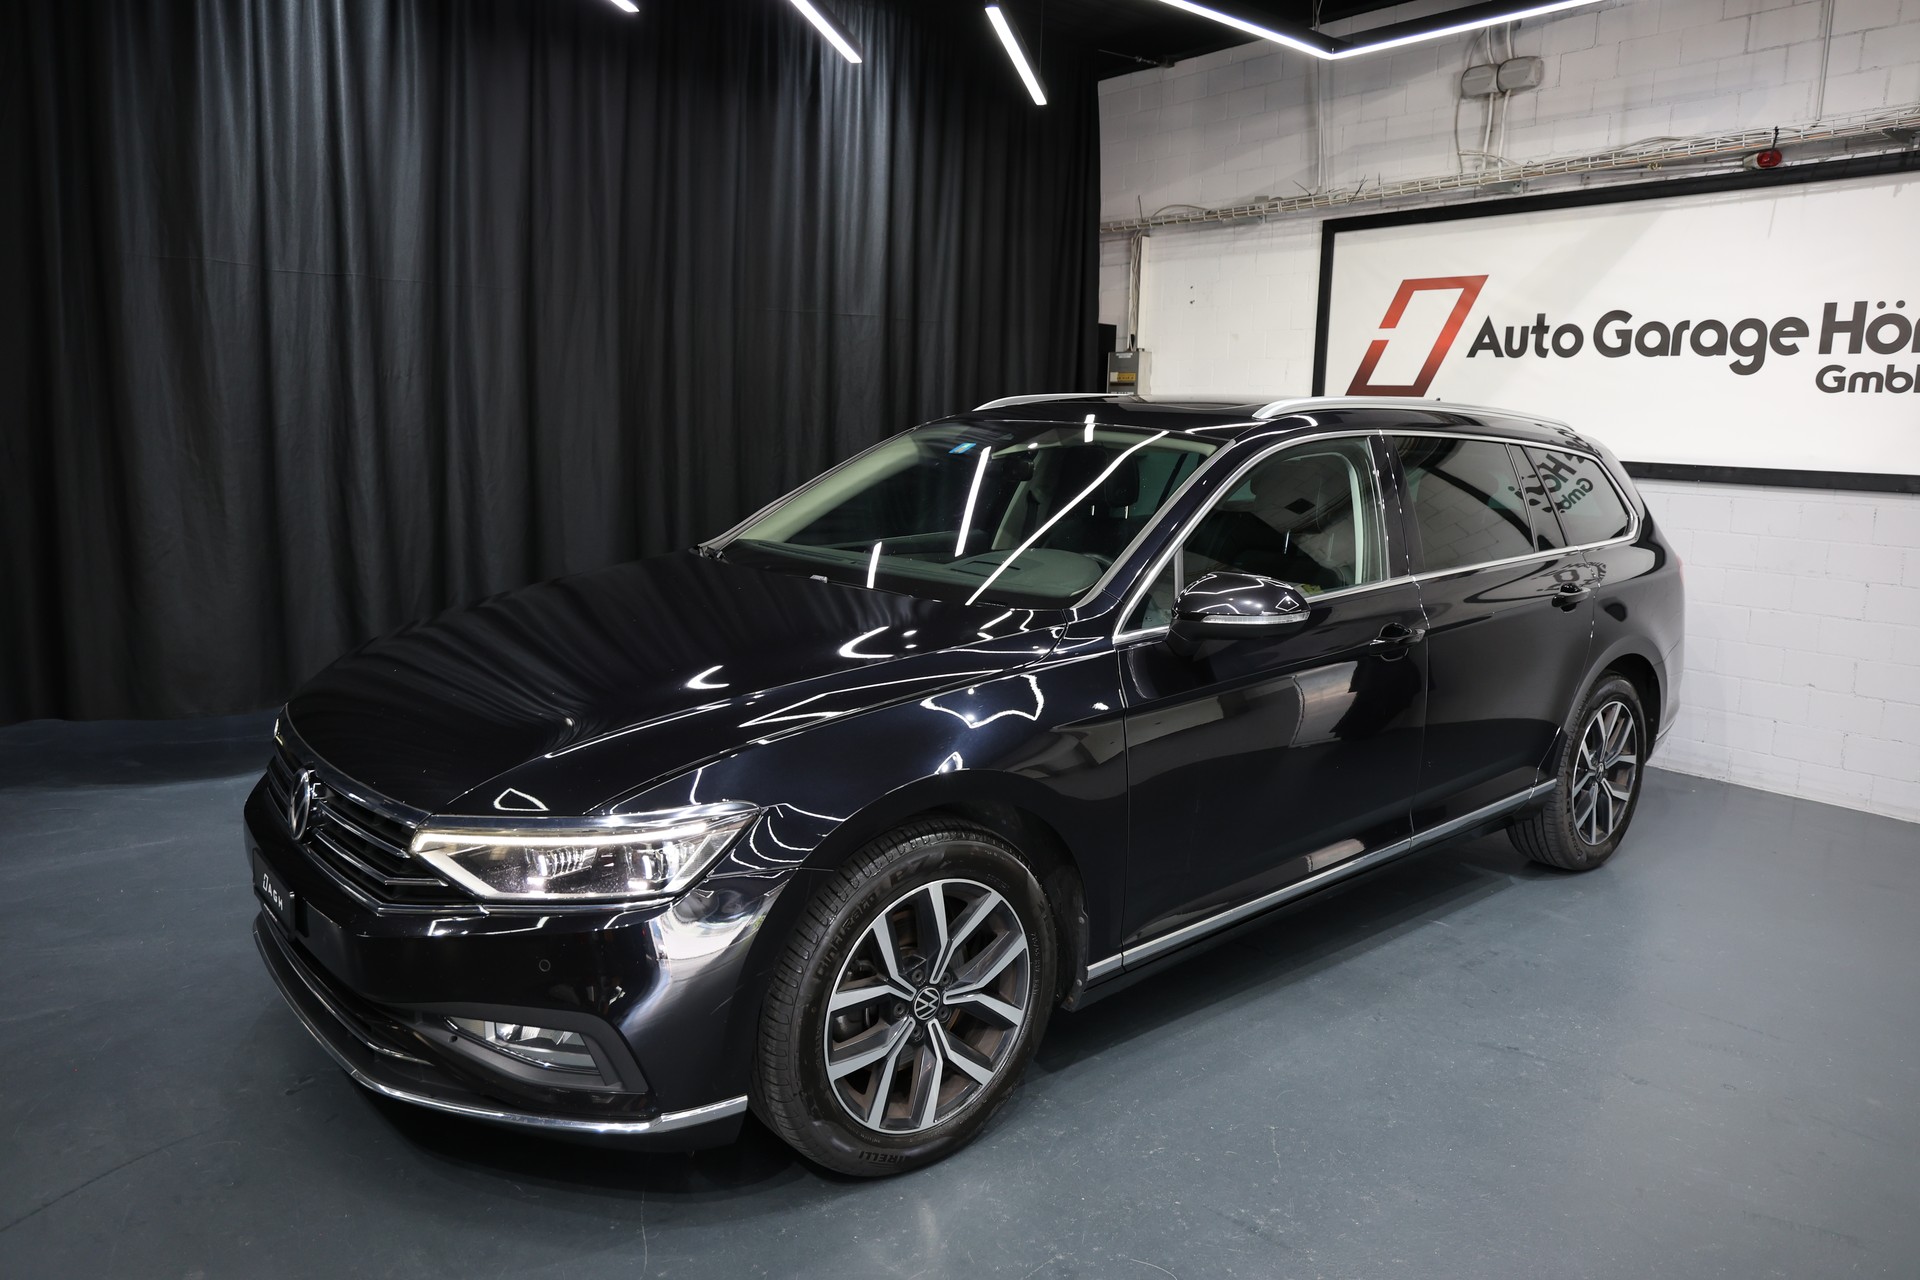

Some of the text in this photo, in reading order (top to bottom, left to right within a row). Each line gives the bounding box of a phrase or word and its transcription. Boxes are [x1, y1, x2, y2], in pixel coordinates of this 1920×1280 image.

[1467, 313, 1585, 358] Auto
[1593, 310, 1809, 376] Garage
[1815, 364, 1920, 394] Gmb
